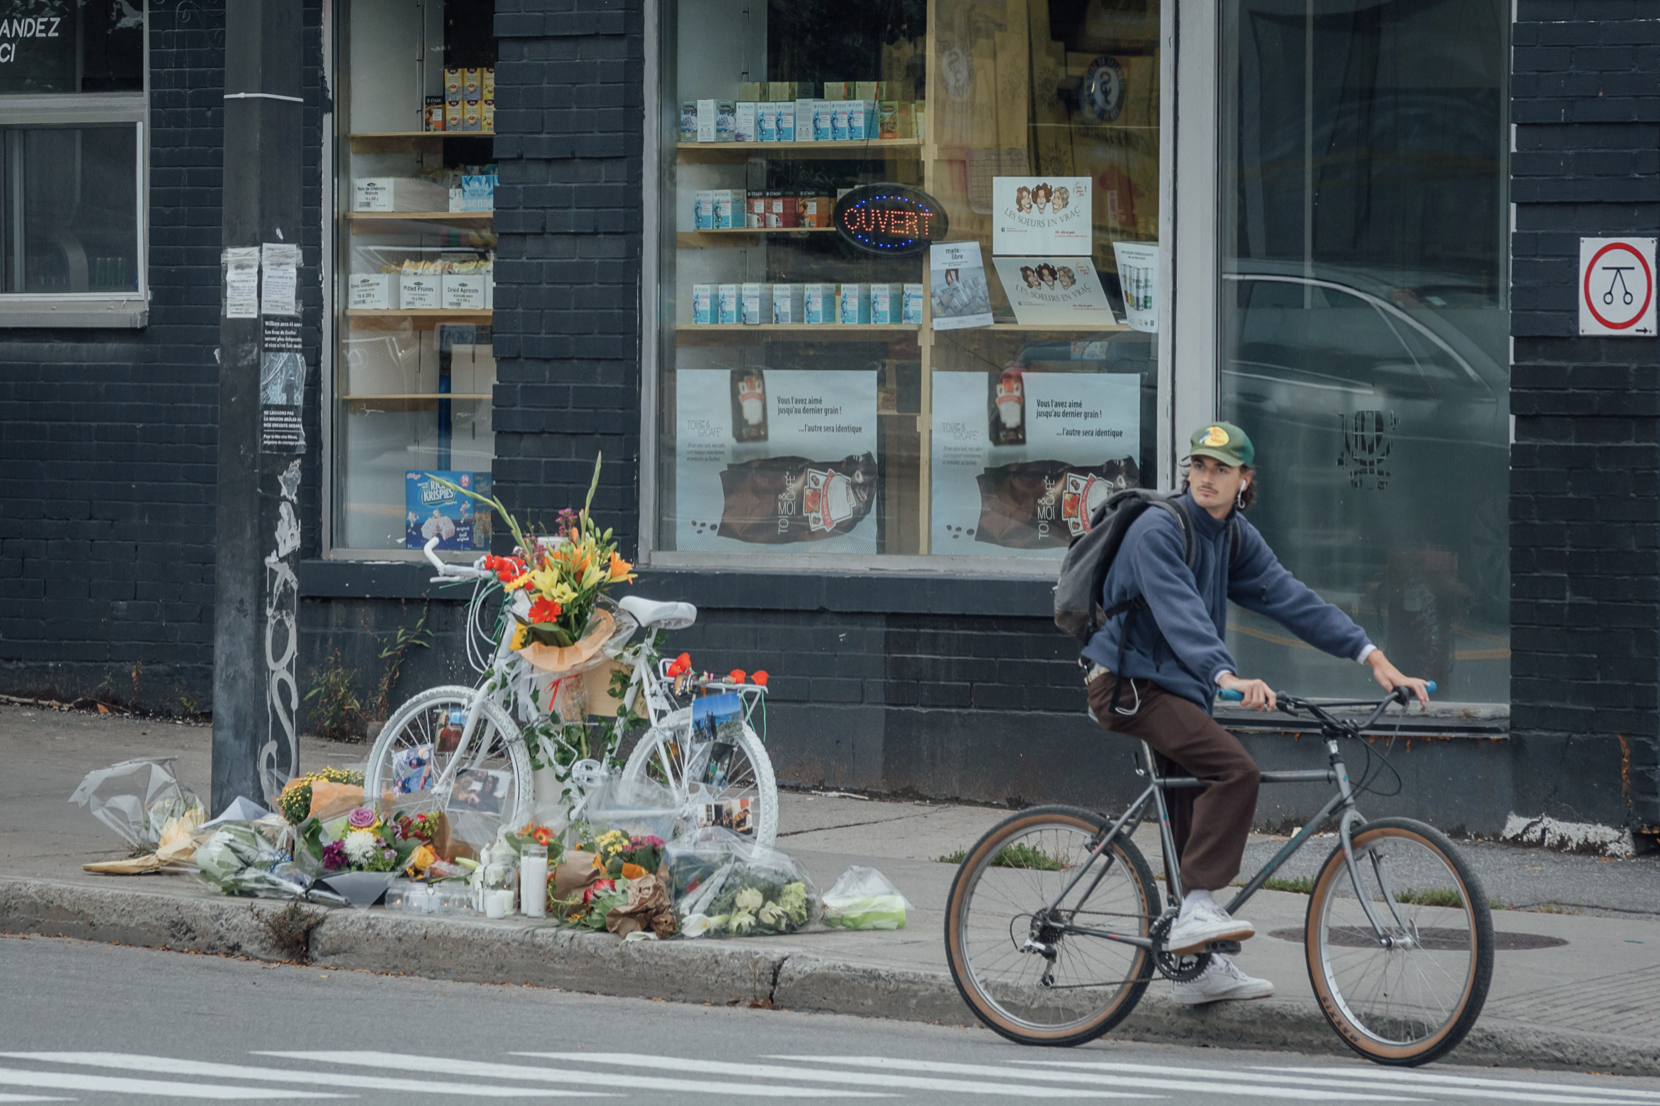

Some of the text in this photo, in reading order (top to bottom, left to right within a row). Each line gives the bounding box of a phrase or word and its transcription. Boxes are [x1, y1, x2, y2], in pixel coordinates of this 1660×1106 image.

[0, 17, 60, 38] ANDEZ
[844, 208, 933, 236] OUVERT
[1005, 207, 1016, 220] LES
[1017, 215, 1045, 227] SOEURS
[1047, 218, 1057, 227] EN
[1015, 284, 1028, 295] LES
[1030, 291, 1060, 301] SOEURS
[1061, 293, 1071, 301] EN
[777, 396, 822, 405] Vous l'avez aimé
[1037, 399, 1082, 408] Vous l'avez aimé
[777, 406, 801, 416] jusqu'au
[802, 406, 822, 414] dernier
[824, 406, 838, 416] grain
[1036, 409, 1060, 419] jusqu'au
[1062, 409, 1082, 418] dernier
[1084, 410, 1098, 420] grain
[836, 424, 862, 435] identique
[1095, 428, 1123, 439] identique
[423, 489, 454, 502] KRISPIES
[785, 474, 796, 500] CAFÉ
[1044, 479, 1055, 506] CAFÉ
[778, 492, 796, 535] TOI MOI &
[1038, 506, 1055, 520] MOI
[1039, 521, 1049, 540] TOI
[1322, 996, 1360, 1042] MAXXIS
